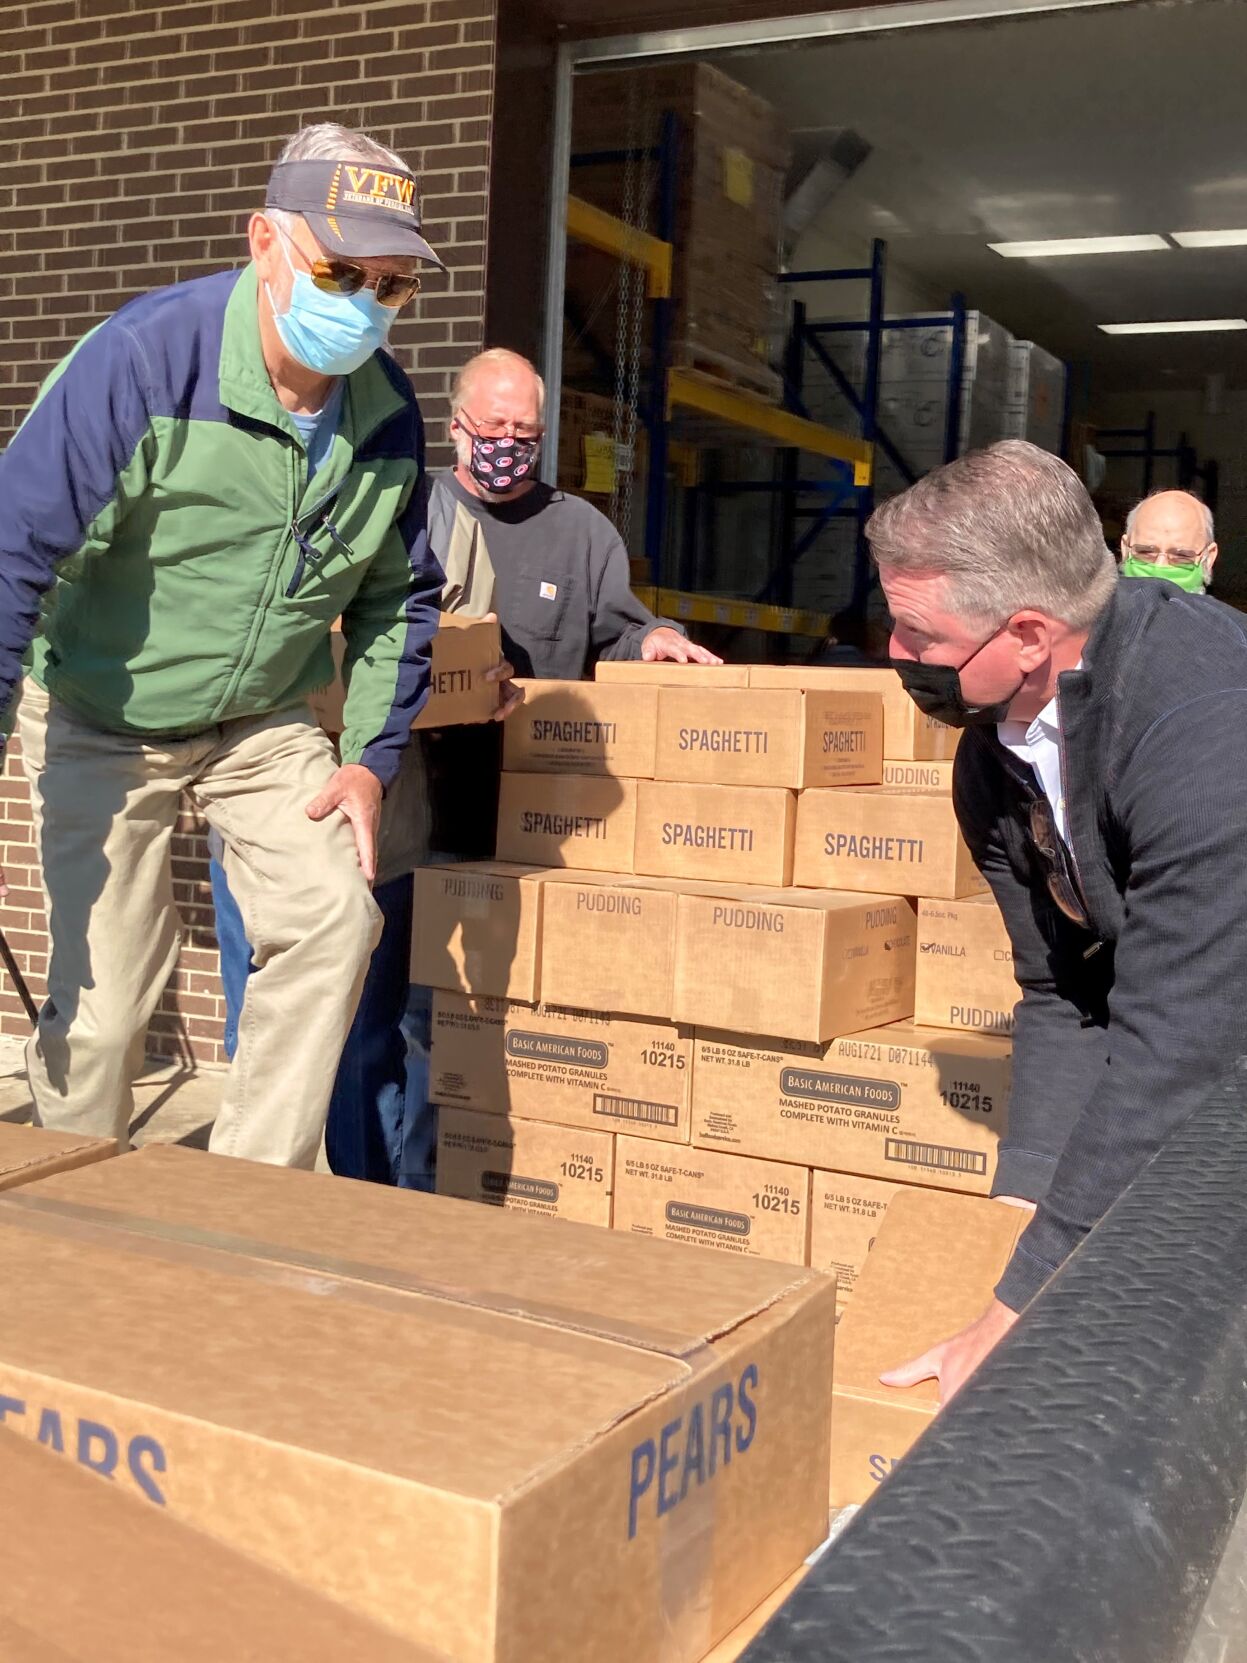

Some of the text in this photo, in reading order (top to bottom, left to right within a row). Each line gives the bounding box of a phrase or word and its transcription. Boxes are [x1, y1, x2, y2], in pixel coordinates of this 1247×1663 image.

[345, 165, 416, 206] VFW
[430, 669, 472, 695] HETTI
[533, 720, 616, 744] SPAGHETTI
[678, 728, 768, 754] SPAGHETTI
[823, 730, 866, 753] SPAGHETTI
[884, 767, 940, 786] UDDING
[522, 811, 607, 840] SPAGHETTI
[662, 822, 753, 852] SPAGHETTI
[824, 832, 924, 863] SPAGHETTI
[577, 892, 642, 915] PUDDING
[713, 906, 784, 933] PUDDING
[865, 907, 897, 929] PUDDING
[930, 943, 966, 957] VANILLA
[950, 1006, 1016, 1030] PUDDIN
[512, 1037, 602, 1061] BASIC AMERICAN FOODS
[652, 1041, 675, 1051] 11140
[838, 1041, 881, 1061] AUG1721
[506, 1059, 608, 1081] MASHED POTATO GRANULES
[640, 1049, 686, 1070] 10215
[701, 1055, 714, 1063] NET
[742, 1060, 751, 1068] LB
[506, 1069, 544, 1082] COMPLETE
[546, 1075, 565, 1085] WITH
[566, 1077, 599, 1090] VITAMIN
[600, 1083, 606, 1091] C
[788, 1075, 893, 1101] BASIC AMERICAN FOODS
[953, 1081, 981, 1093] 11140
[779, 1098, 901, 1123] MASHED POTATO GRANULES
[939, 1091, 993, 1113] 10215
[780, 1109, 825, 1123] COMPLETE
[827, 1116, 850, 1127] WITH
[852, 1120, 890, 1134] VITAMIN
[891, 1126, 898, 1134] C
[570, 1153, 594, 1165] 11140
[560, 1162, 604, 1182] 10215
[625, 1168, 638, 1176] NET
[535, 1185, 554, 1196] FOODS
[763, 1184, 790, 1196] 11140
[752, 1193, 800, 1215] 10215
[824, 1202, 837, 1211] NET
[671, 1207, 745, 1229] BASIC AMERICAN FOODS
[665, 1223, 691, 1233] MASHED
[692, 1228, 716, 1239] POTATO
[717, 1233, 750, 1246] GRANULES
[666, 1232, 697, 1244] COMPLETE
[699, 1237, 715, 1247] WITH
[715, 1240, 742, 1253] VITAMIN
[628, 1363, 759, 1541] PEARS
